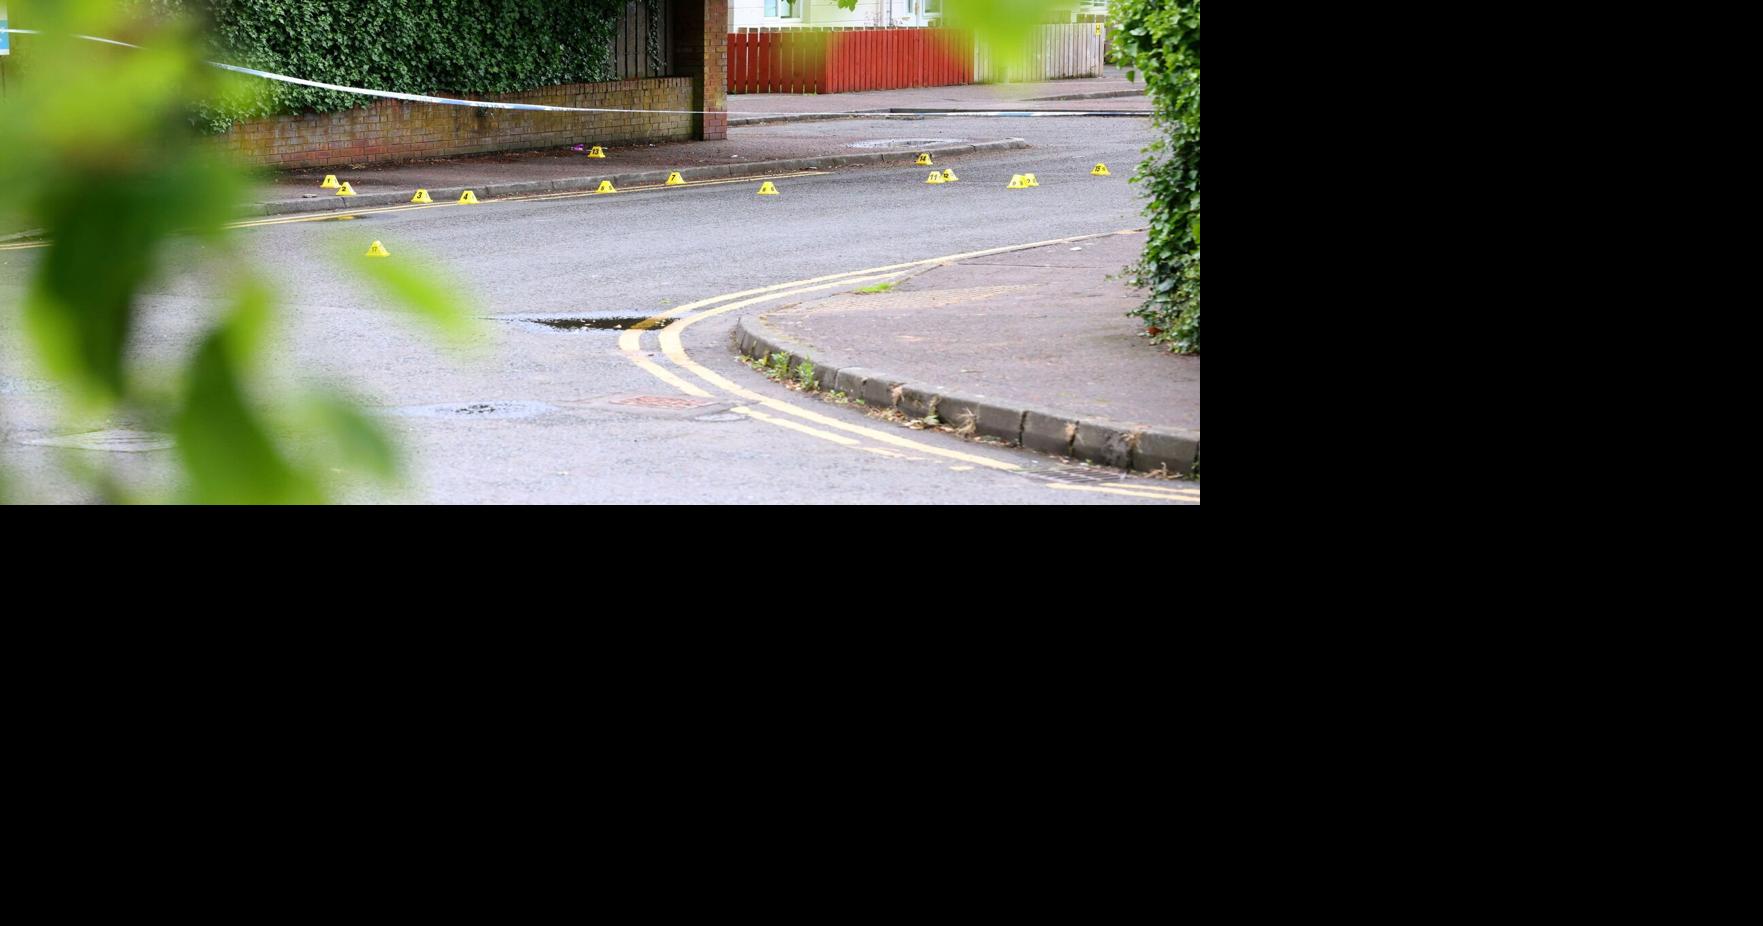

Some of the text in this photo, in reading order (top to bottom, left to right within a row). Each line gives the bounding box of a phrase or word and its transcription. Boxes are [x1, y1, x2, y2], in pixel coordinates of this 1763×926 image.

[929, 173, 938, 181] 11
[416, 191, 423, 199] 3
[463, 192, 469, 200] 4
